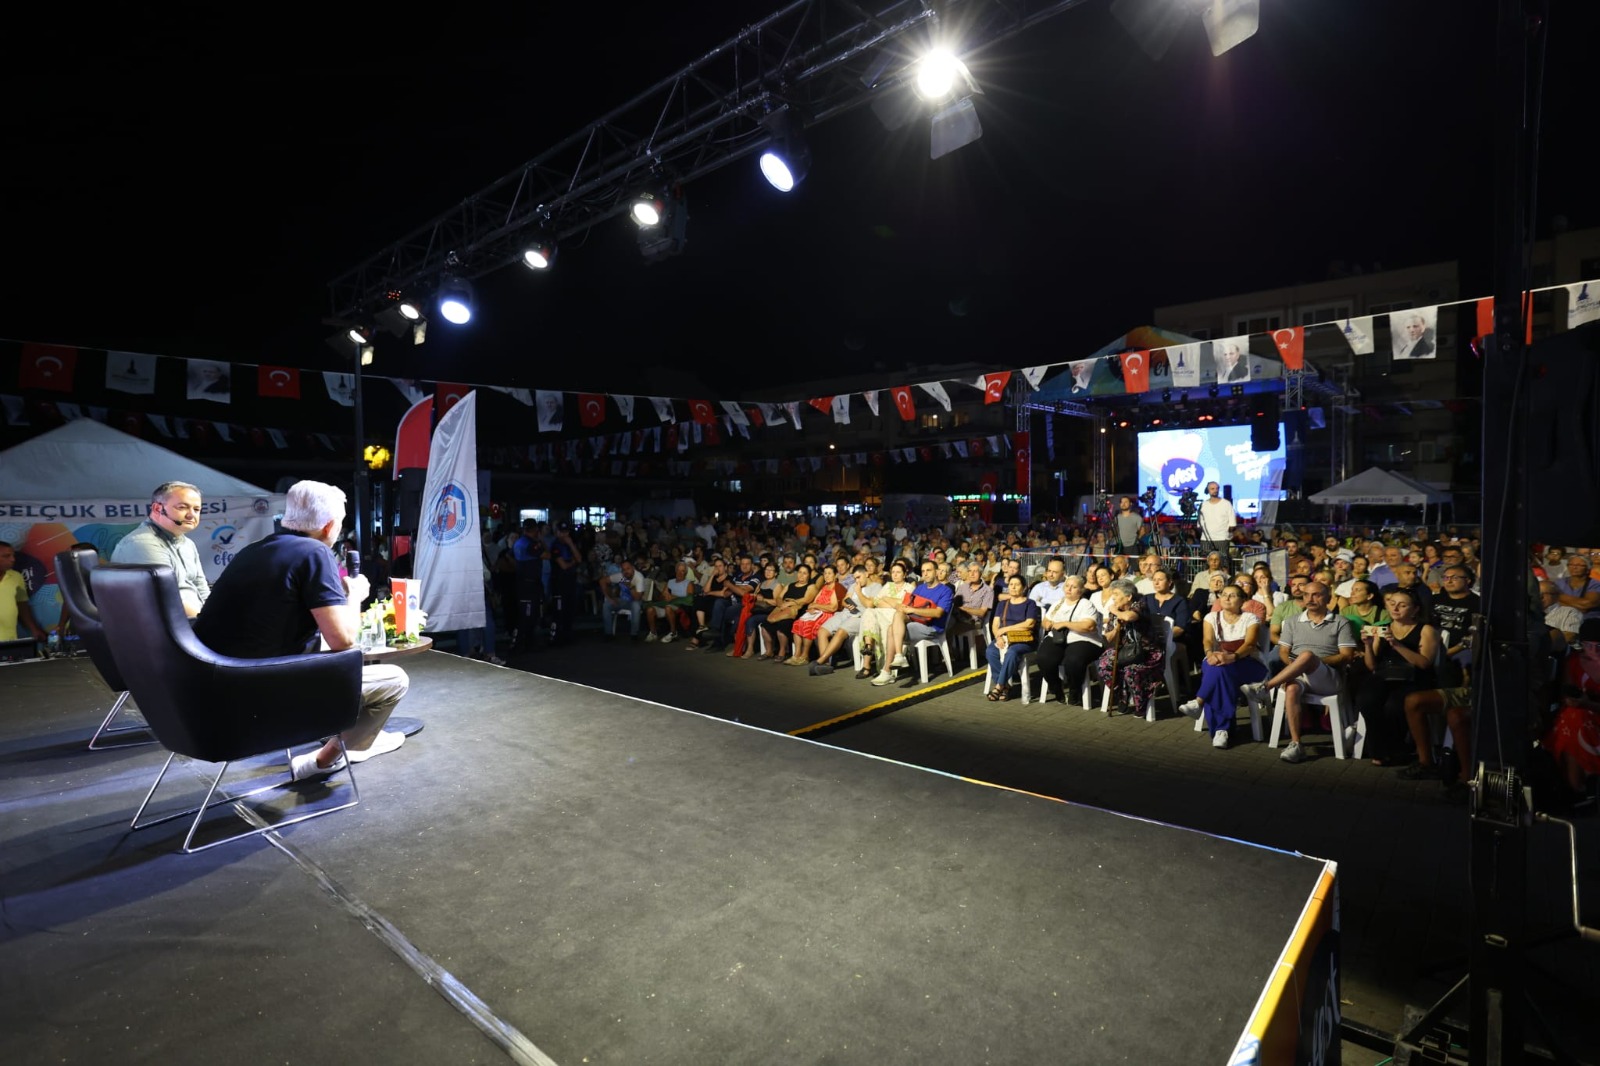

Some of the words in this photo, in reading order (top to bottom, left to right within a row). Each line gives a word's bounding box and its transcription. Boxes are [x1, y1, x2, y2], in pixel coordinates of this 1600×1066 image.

[1168, 463, 1198, 488] efest
[0, 504, 95, 521] SELÇUK
[104, 499, 227, 518] BELESİ
[213, 551, 234, 566] efe
